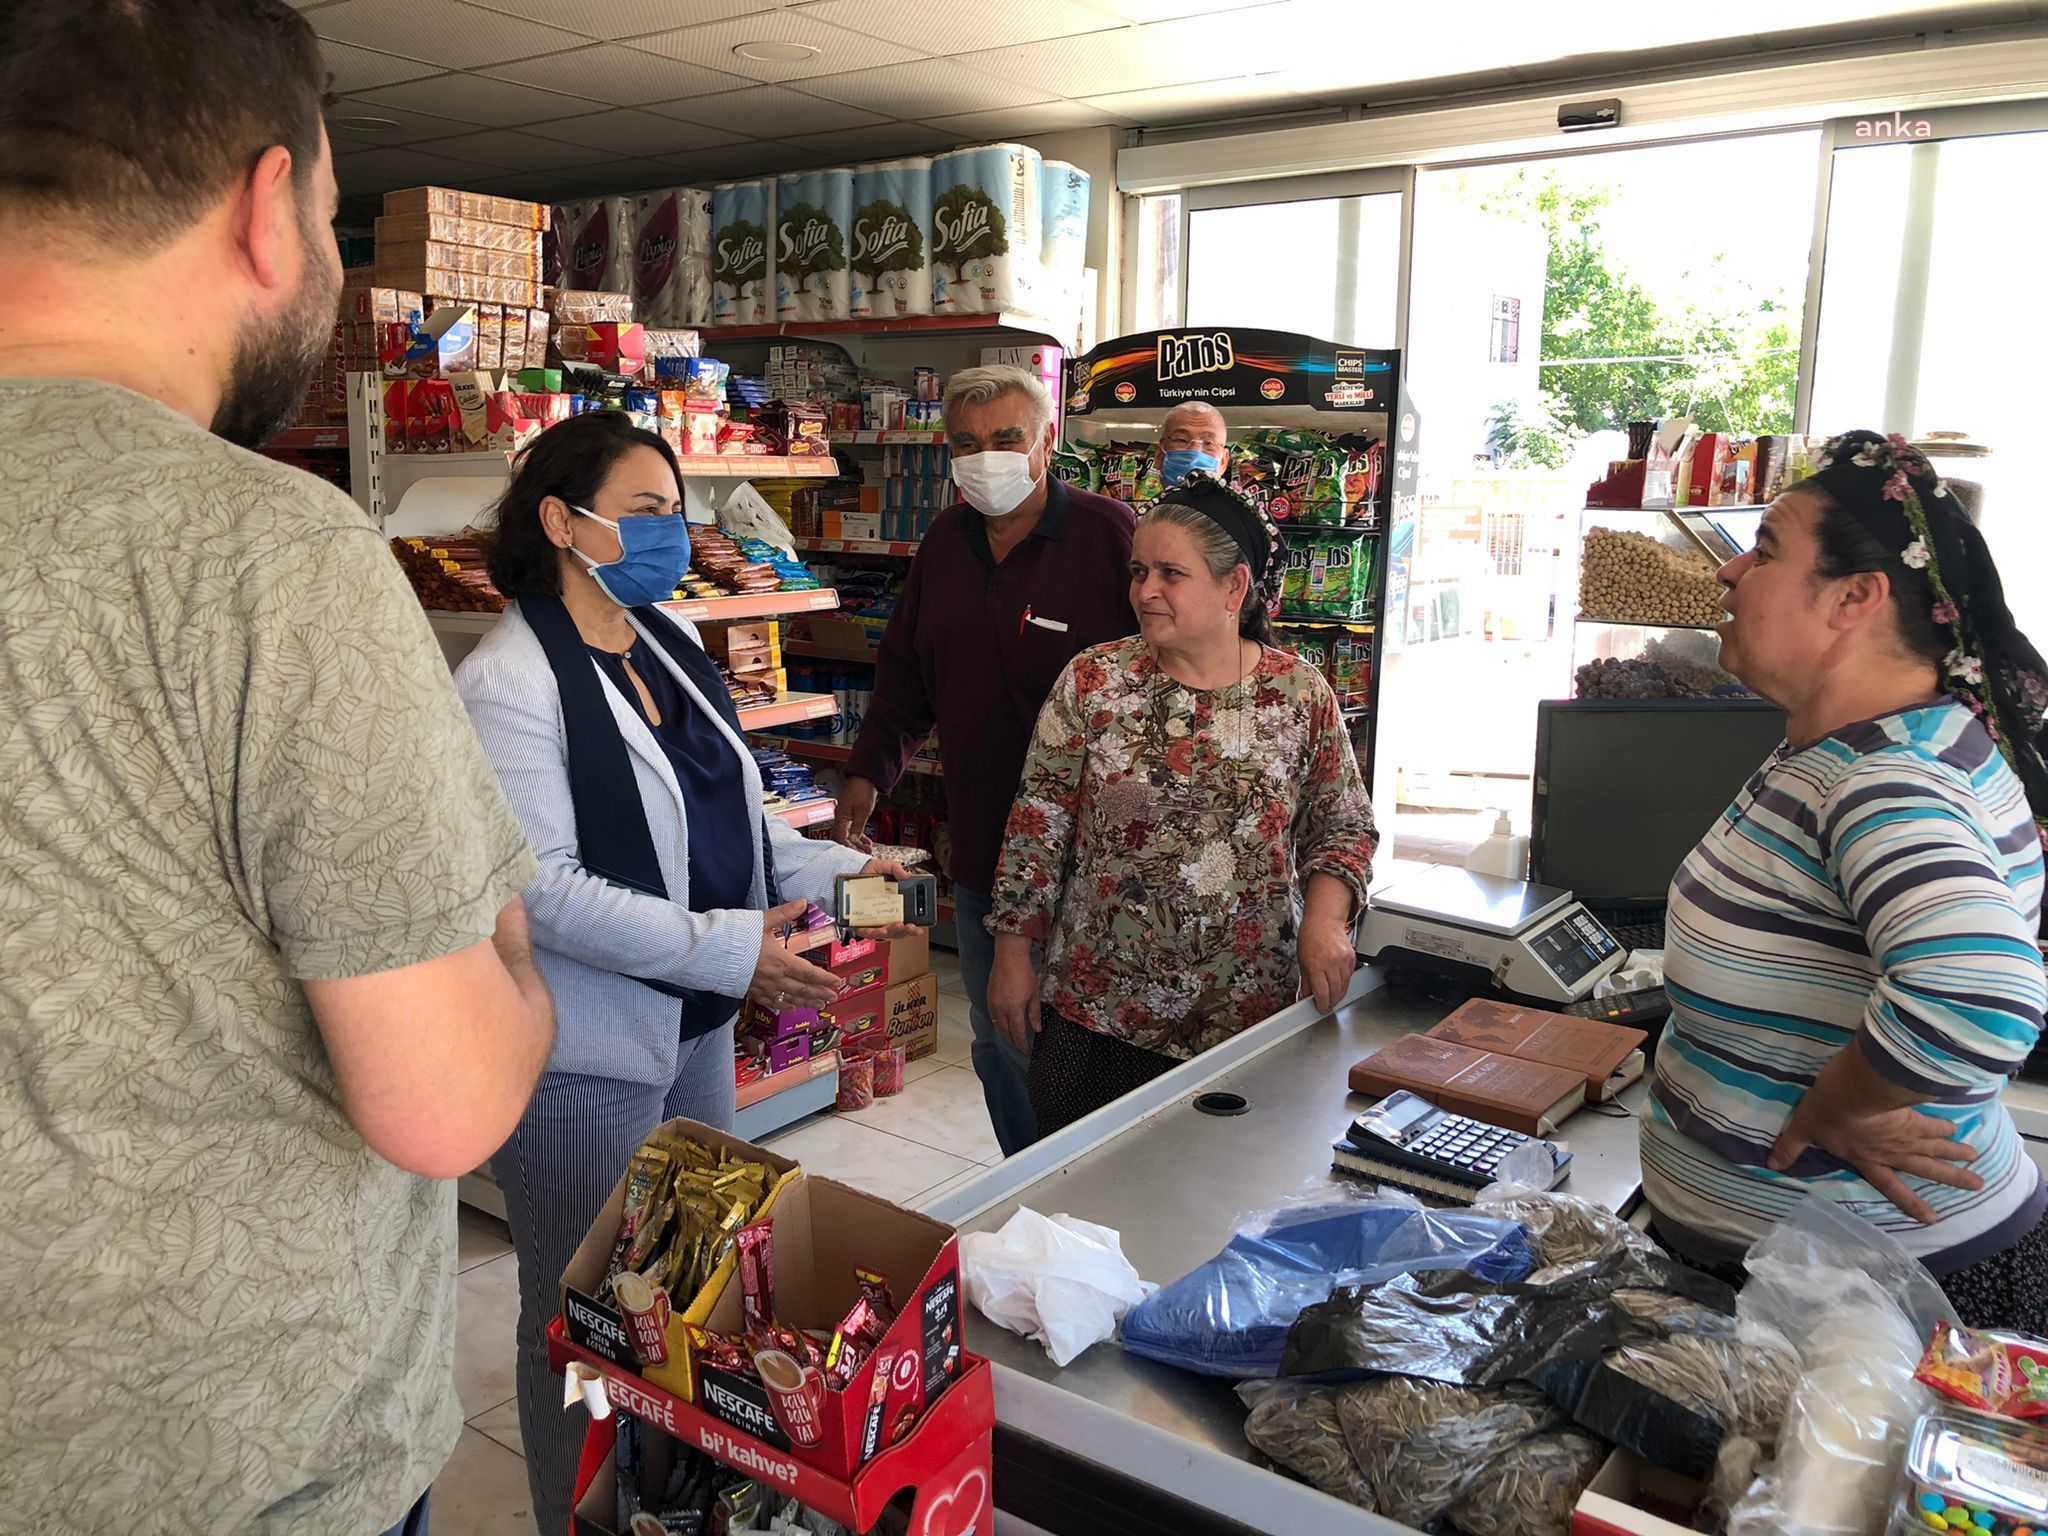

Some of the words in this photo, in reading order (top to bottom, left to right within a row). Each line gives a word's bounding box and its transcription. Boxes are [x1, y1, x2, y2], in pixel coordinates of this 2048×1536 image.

[777, 218, 829, 263] Sofia
[851, 215, 908, 261] Sofia
[932, 200, 990, 252] Sofia
[715, 235, 764, 273] Sofia
[1337, 358, 1363, 367] CHIPS
[1337, 366, 1363, 374] MASTER
[1159, 387, 1210, 399] Türkiye'nin
[1211, 387, 1236, 398] Cipsi
[892, 995, 927, 1016] ÜLKER
[568, 1298, 628, 1347] NESCAFÉ
[703, 1378, 774, 1432] NESCAFÉ
[719, 1409, 764, 1437] ORIGINAL
[796, 1424, 815, 1443] TAT
[727, 1437, 799, 1485] kahve?
